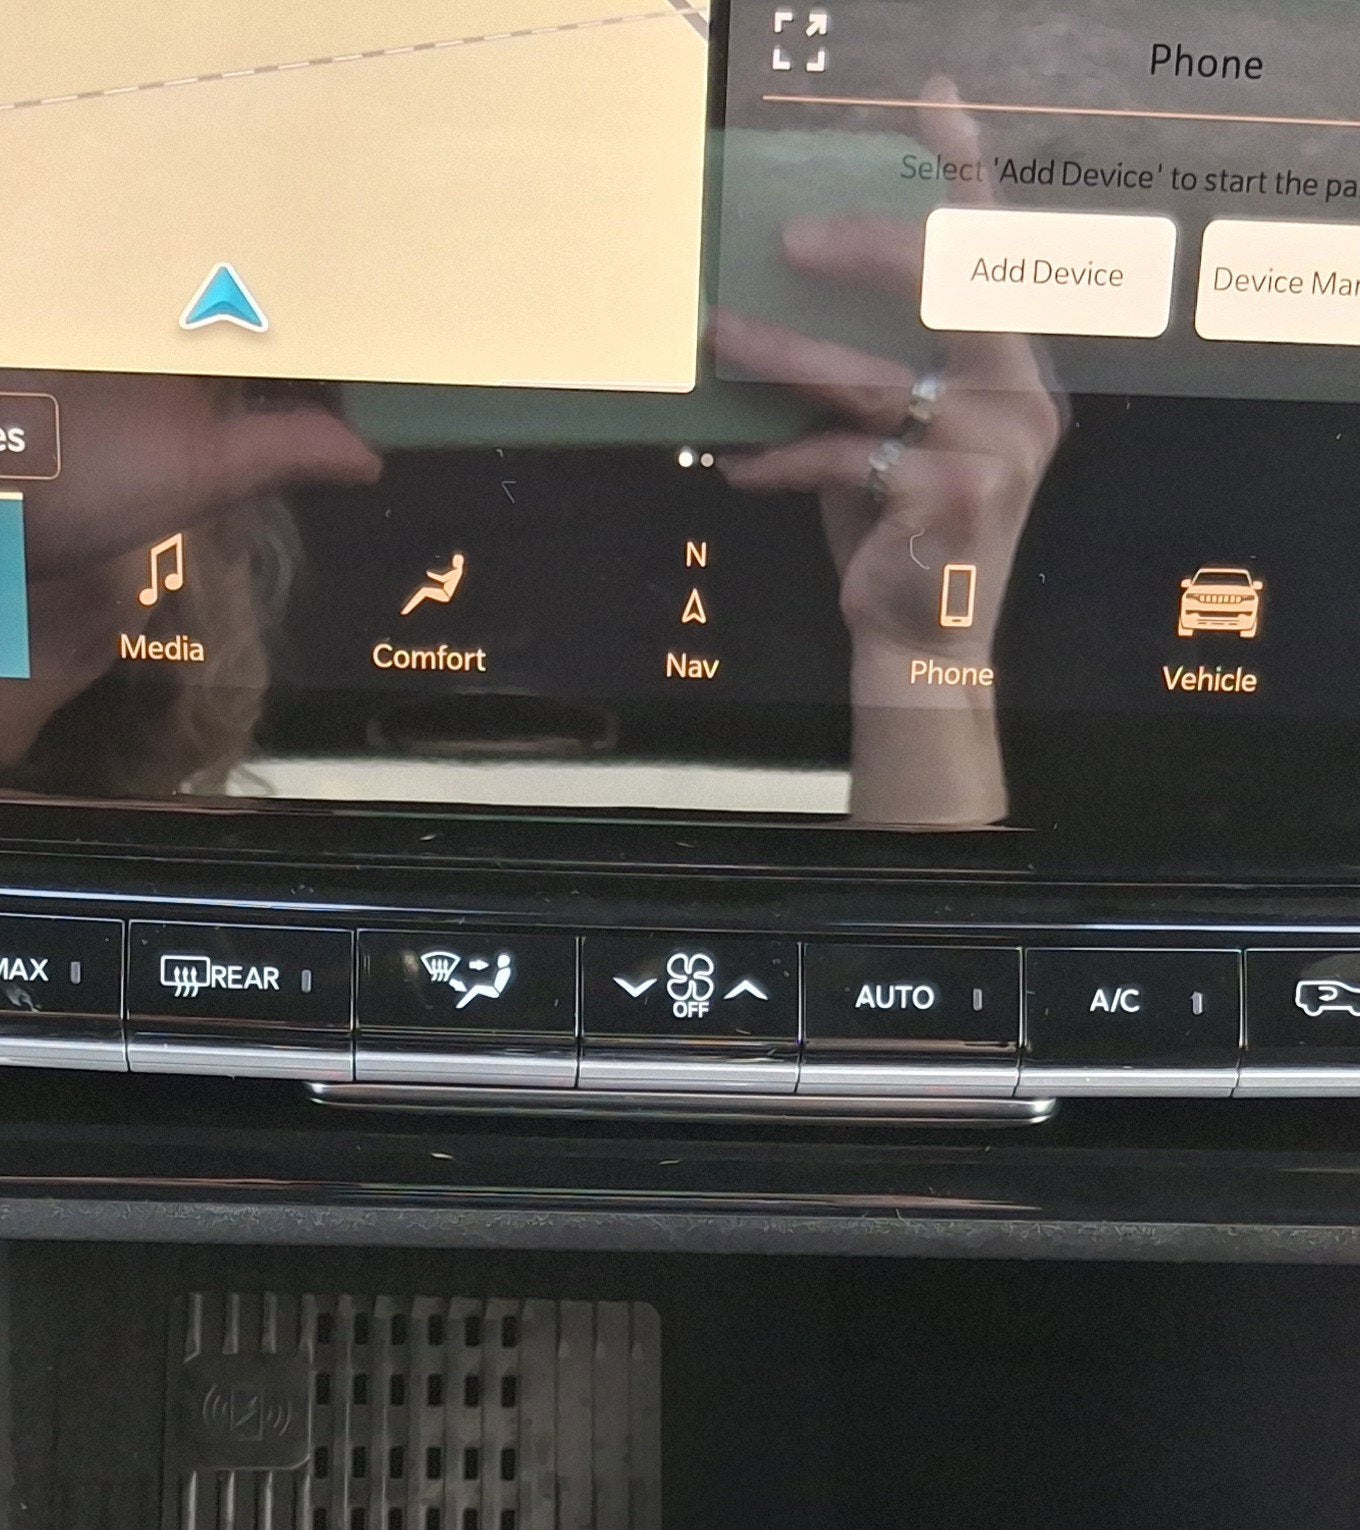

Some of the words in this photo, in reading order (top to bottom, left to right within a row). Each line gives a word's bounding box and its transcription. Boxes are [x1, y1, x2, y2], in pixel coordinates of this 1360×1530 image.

[1149, 43, 1264, 82] Phone
[901, 154, 983, 181] Select
[994, 157, 1055, 185] 'Add
[1062, 161, 1163, 188] Device'
[1172, 168, 1197, 190] to
[1205, 169, 1267, 194] start
[1275, 170, 1318, 196] the
[971, 258, 1025, 283] Add
[1033, 259, 1124, 287] Device
[1213, 266, 1303, 294] Device
[685, 541, 707, 567] N
[120, 634, 205, 663] Media
[372, 642, 487, 674] Comfort
[665, 652, 720, 680] Nav
[910, 658, 994, 688] Phone
[1162, 665, 1259, 694] Vehicle
[210, 965, 280, 992] REAR
[672, 1000, 709, 1019] OFF
[855, 985, 934, 1010] AUTO
[1089, 986, 1140, 1014] A/C
